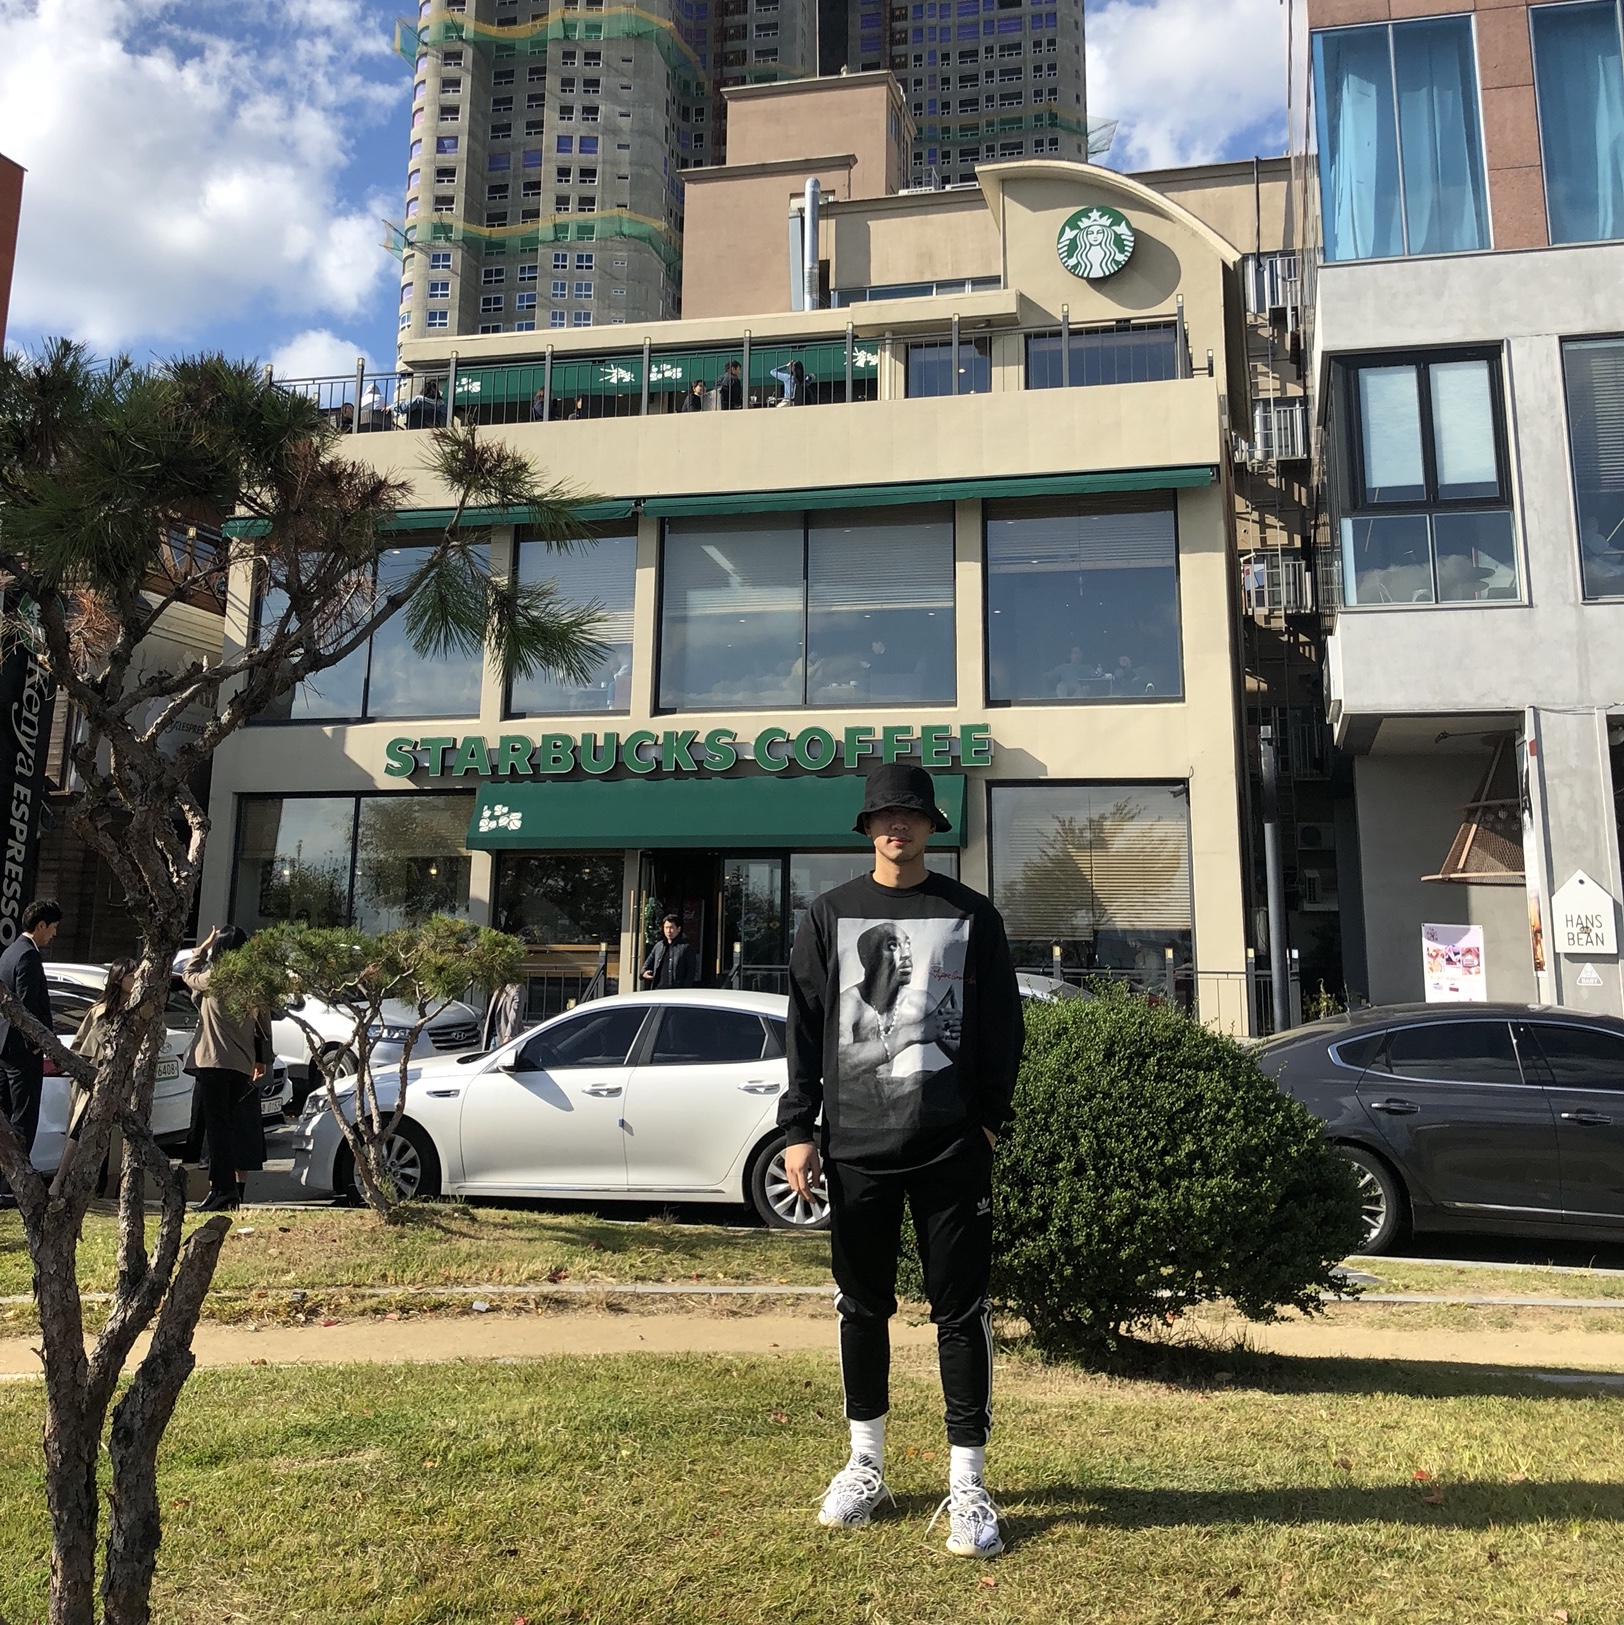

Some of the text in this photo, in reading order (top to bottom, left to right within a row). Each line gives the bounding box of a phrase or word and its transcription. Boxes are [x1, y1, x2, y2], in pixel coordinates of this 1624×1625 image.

[383, 722, 993, 779] STARBUCKS COFFEE
[0, 655, 57, 947] Kenya ESPRESSO
[1565, 914, 1603, 928] HANS
[1567, 932, 1605, 946] BEAN
[157, 1063, 175, 1077] 6408
